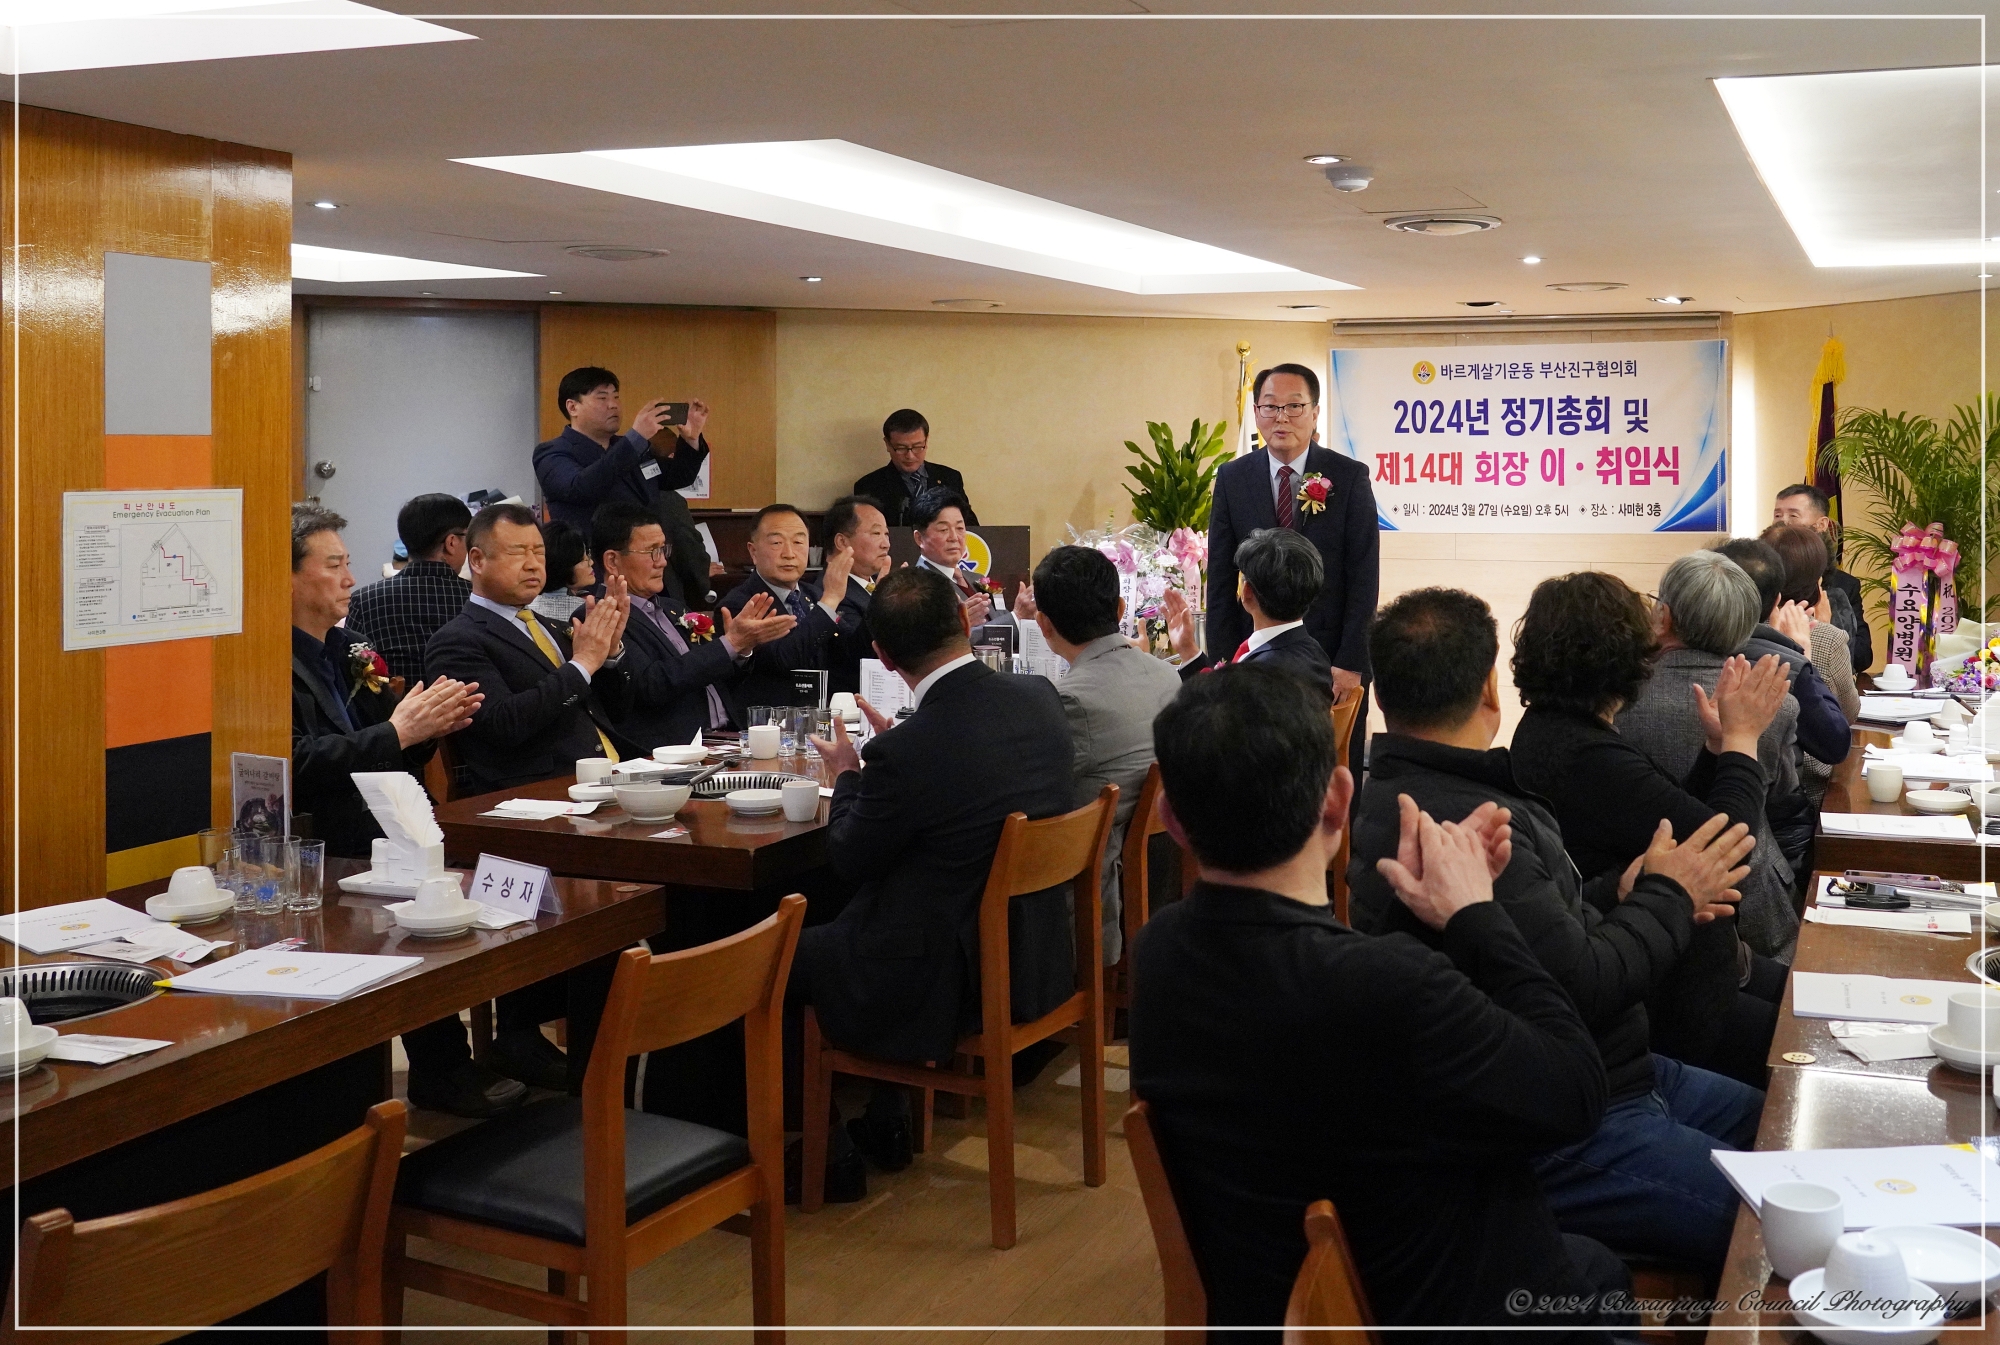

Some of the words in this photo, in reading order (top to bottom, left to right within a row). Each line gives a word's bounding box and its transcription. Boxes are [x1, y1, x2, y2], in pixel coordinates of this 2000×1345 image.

[1440, 362, 1535, 381] 바르게살기운동
[1539, 359, 1638, 380] 부산진구협의회
[1393, 398, 1490, 436] 2024년
[1500, 395, 1611, 436] 정기총회
[1623, 398, 1649, 434] 및
[1375, 451, 1463, 486] 제14대
[1475, 450, 1529, 487] 회장
[112, 511, 154, 519] Emergency
[156, 510, 194, 518] Evacuation
[1403, 503, 1419, 517] 일시
[1428, 503, 1459, 517] 2024년
[1461, 503, 1476, 517] 3월
[1478, 503, 1498, 517] 27일
[1500, 504, 1532, 517] (수요일)
[1535, 504, 1552, 516] 오후
[1554, 504, 1569, 517] 5시
[1590, 503, 1608, 517] 장소
[1618, 503, 1644, 517] 사미헌
[1646, 503, 1662, 517] 3층
[481, 872, 534, 903] 수상자
